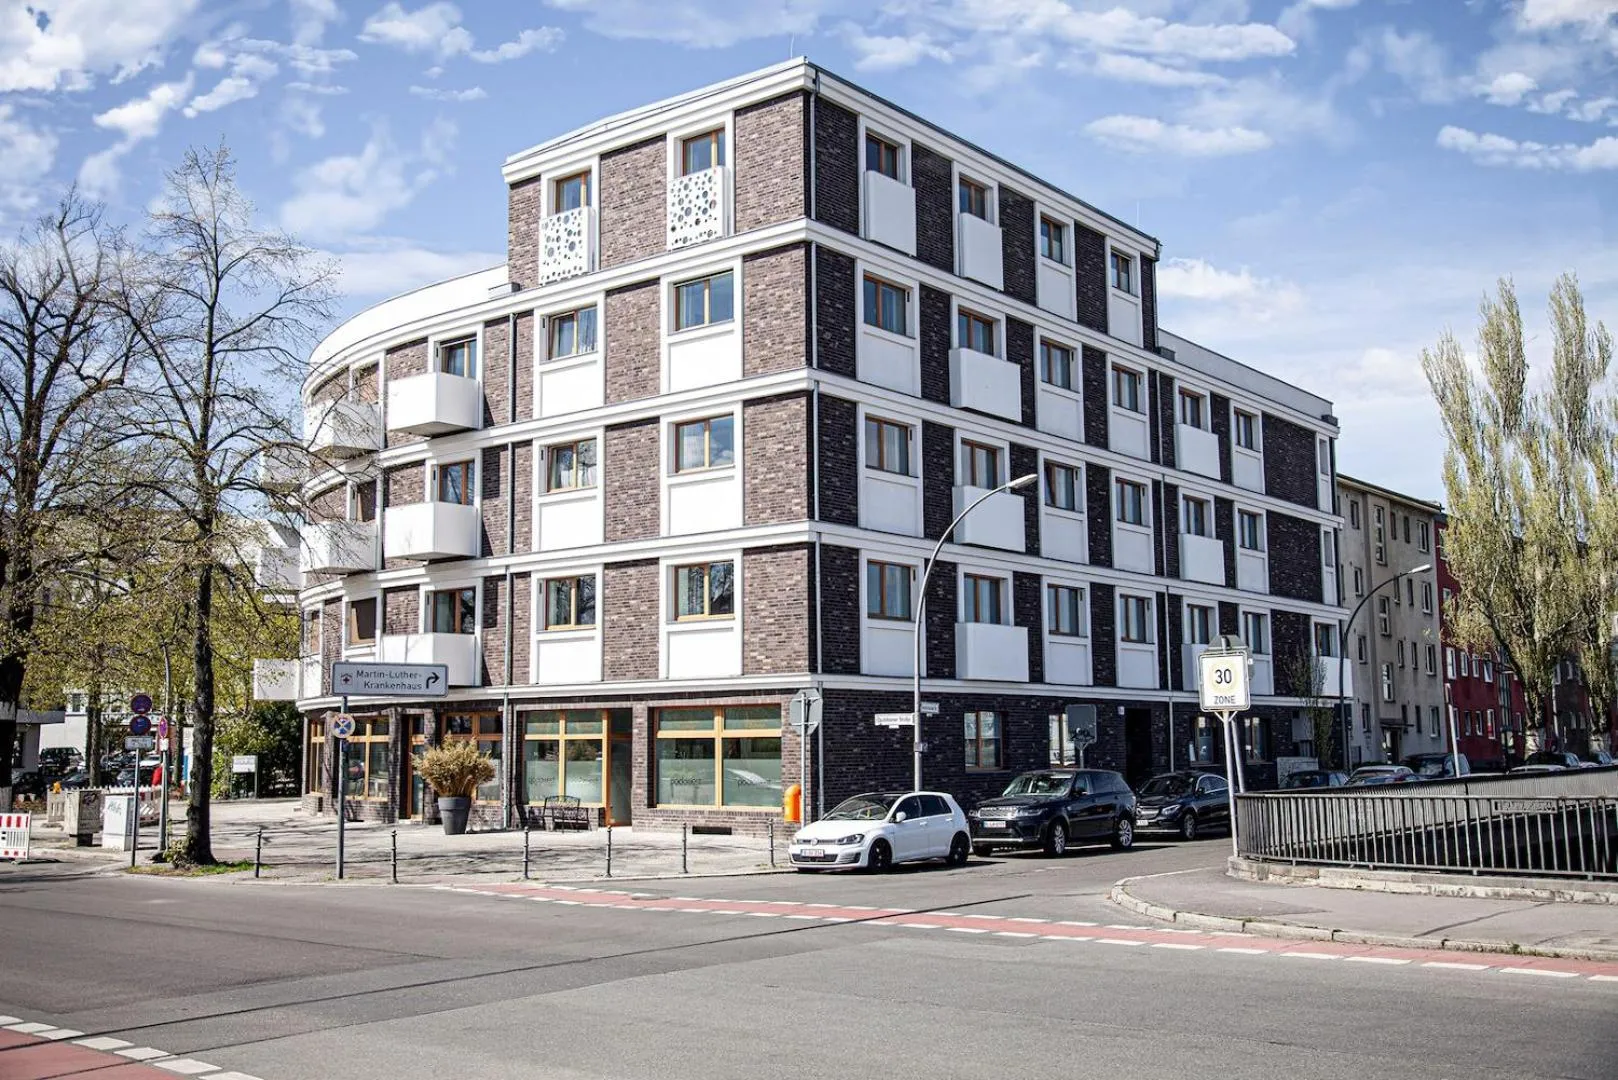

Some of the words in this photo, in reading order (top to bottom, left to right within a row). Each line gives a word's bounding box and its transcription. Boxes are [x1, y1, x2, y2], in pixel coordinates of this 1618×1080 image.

[356, 669, 423, 679] Martin-Luther-
[1215, 668, 1232, 684] 30
[363, 680, 423, 690] Krankenhaus
[1213, 695, 1237, 705] ZONE
